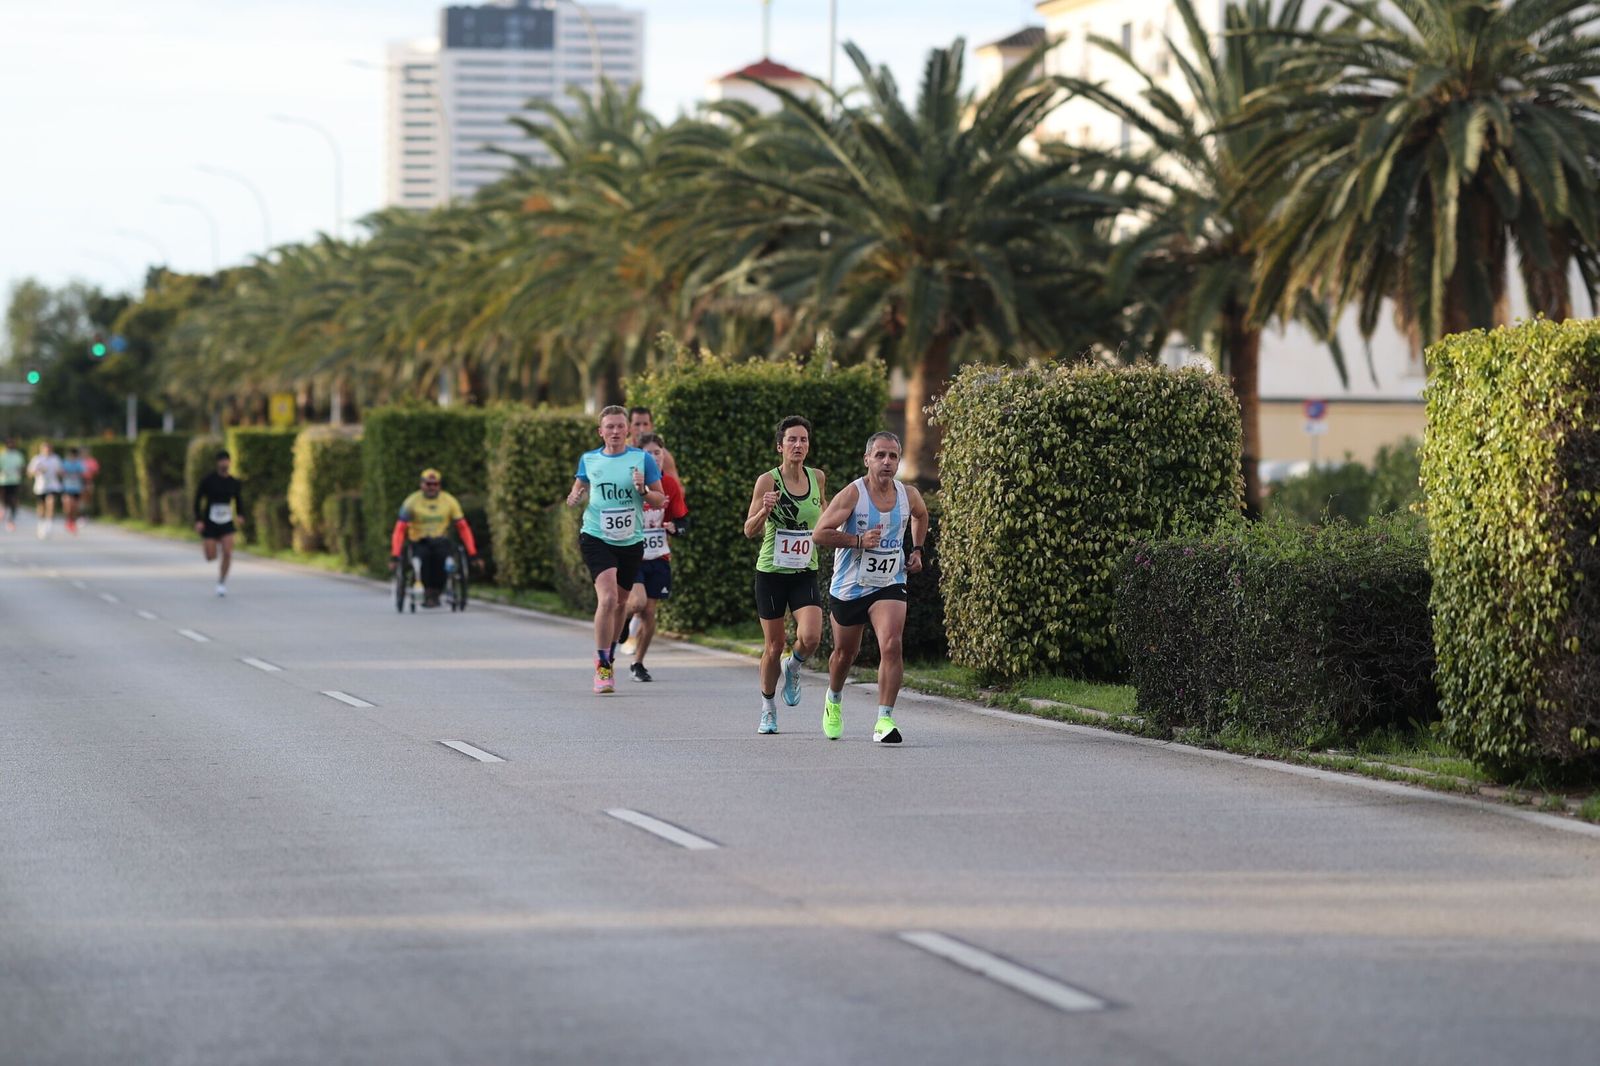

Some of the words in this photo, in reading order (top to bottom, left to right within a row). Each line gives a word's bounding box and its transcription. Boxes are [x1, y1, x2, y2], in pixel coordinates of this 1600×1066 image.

[606, 515, 632, 530] 366
[781, 539, 810, 555] 140
[866, 557, 897, 574] 347
